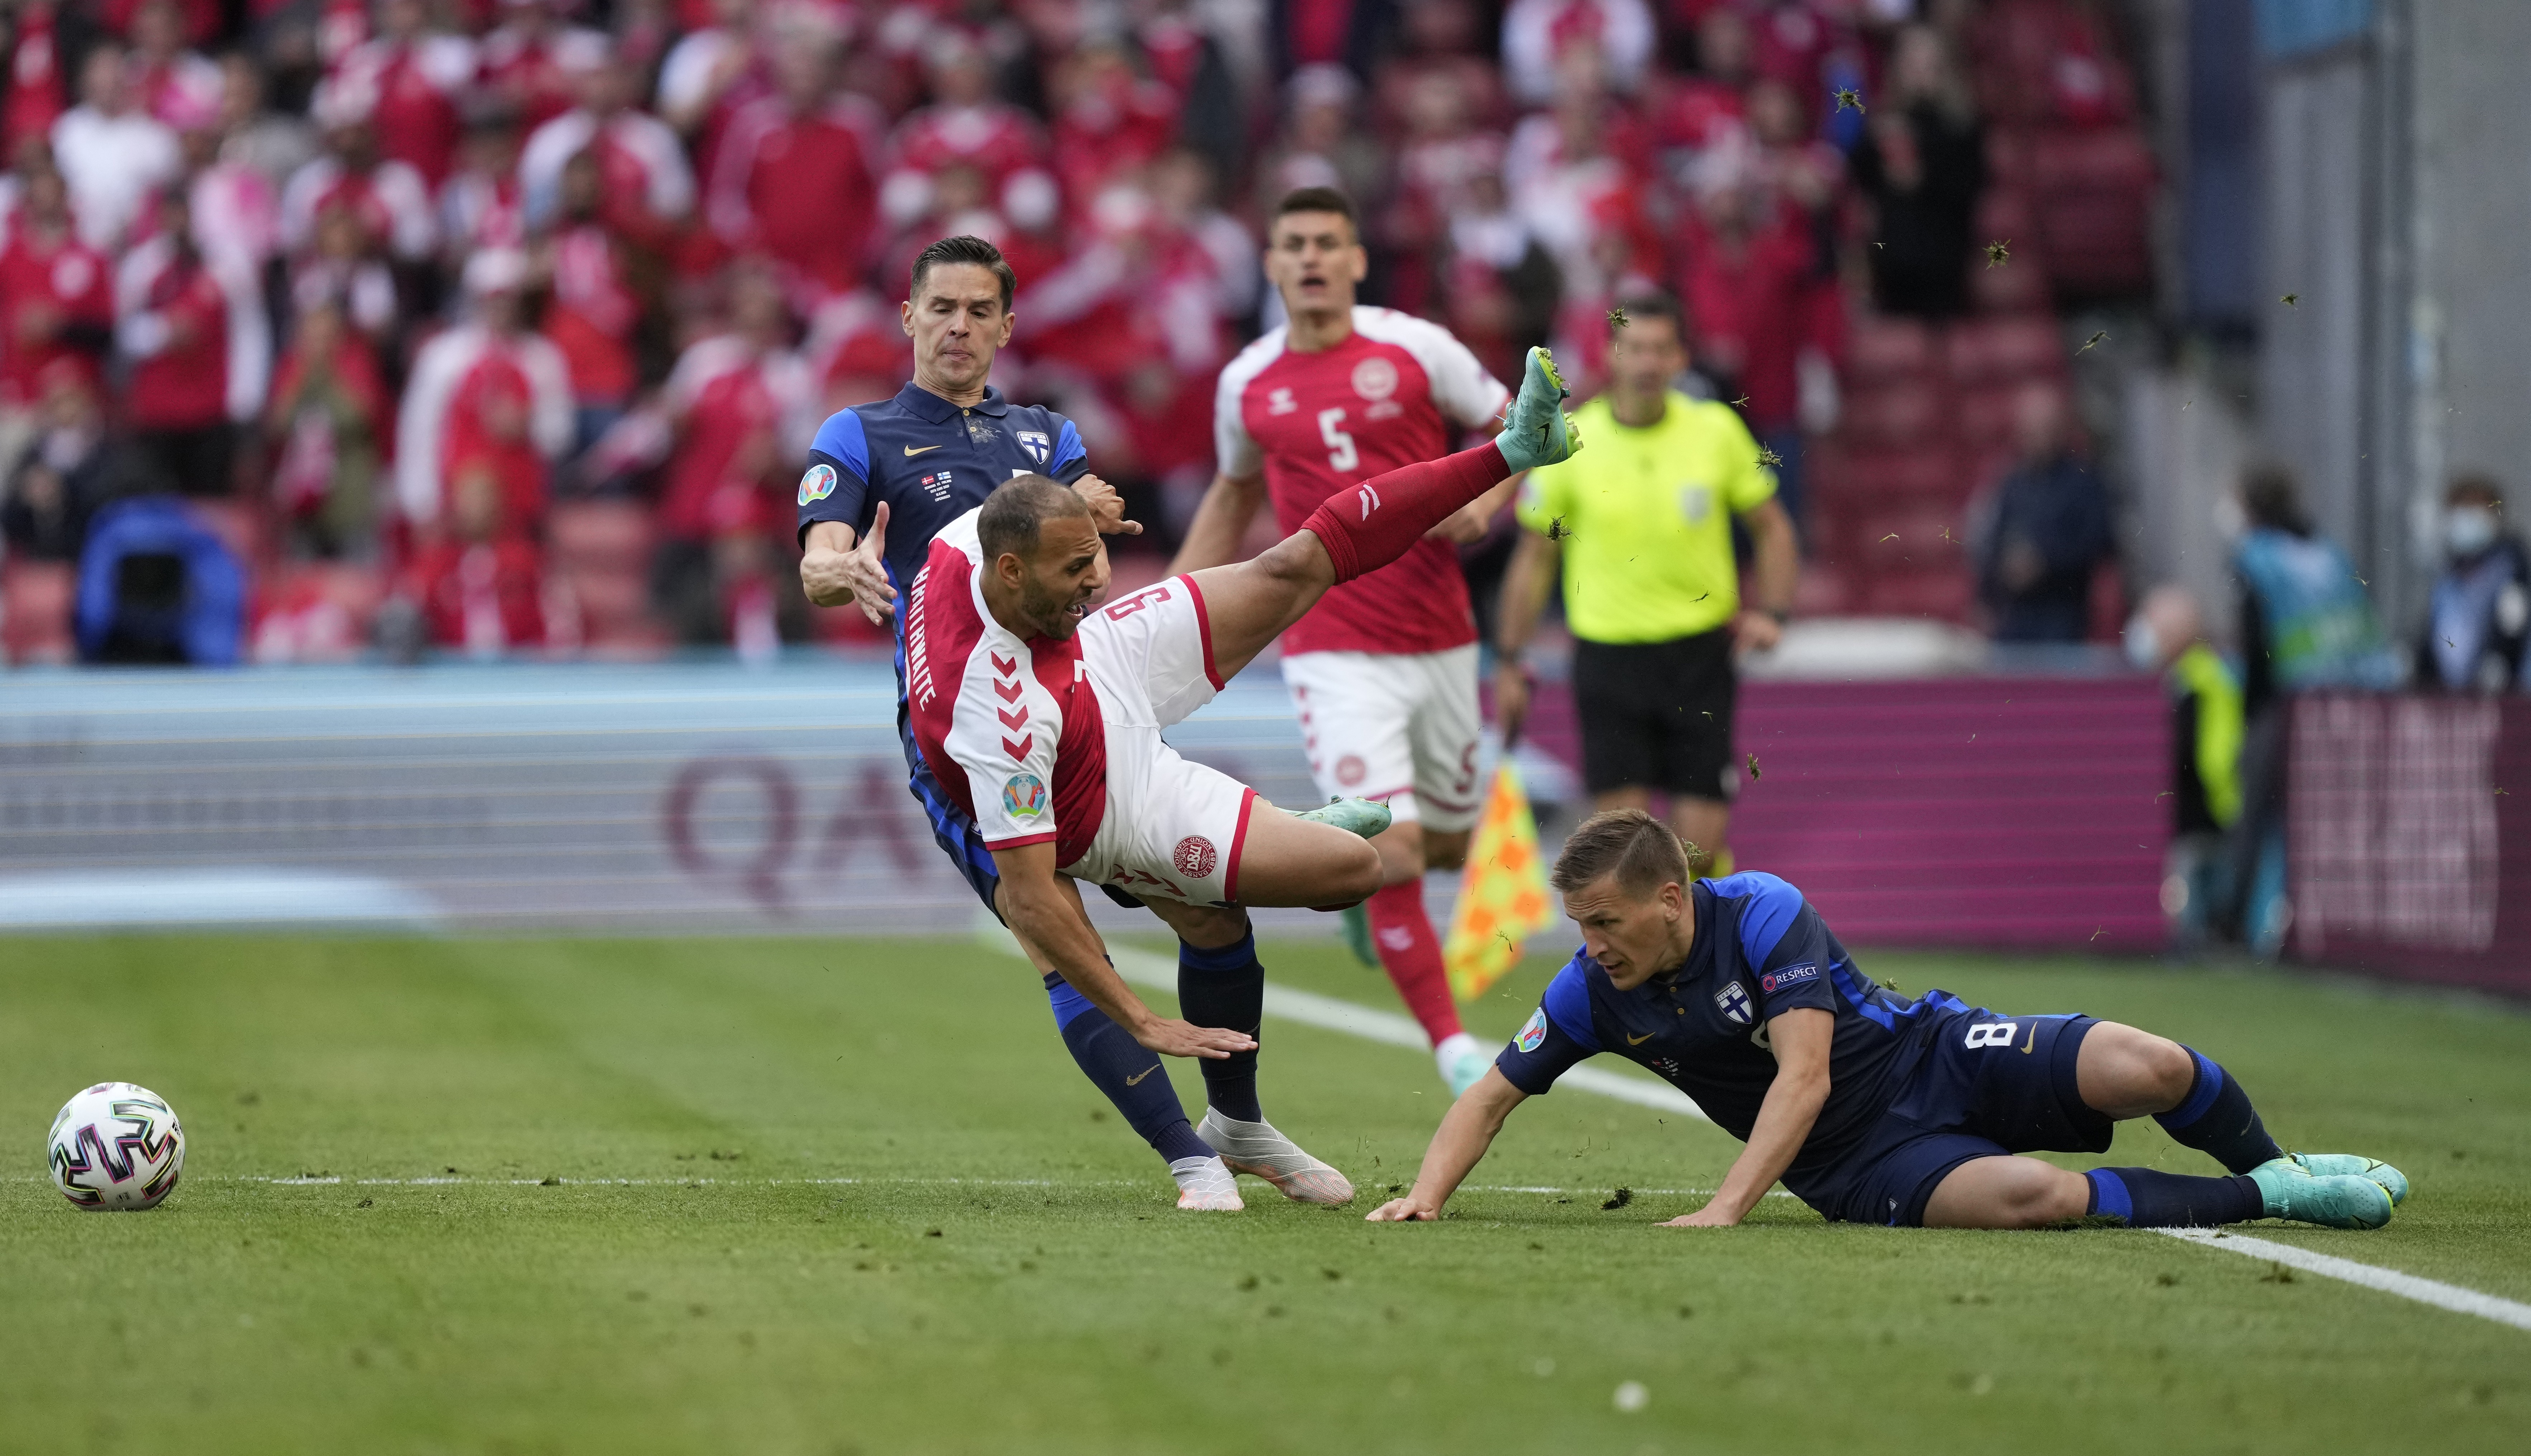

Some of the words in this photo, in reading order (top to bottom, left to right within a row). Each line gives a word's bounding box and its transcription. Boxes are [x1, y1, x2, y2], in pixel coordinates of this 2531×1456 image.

[1317, 408, 1359, 472] 5
[909, 565, 937, 712] BRAITHWAITE
[1186, 844, 1202, 871] DBU
[1183, 869, 1209, 877] DANSK
[1776, 966, 1816, 984] RESPECT
[1718, 986, 1736, 1000] SUOMI
[1964, 1022, 2018, 1049] 8
